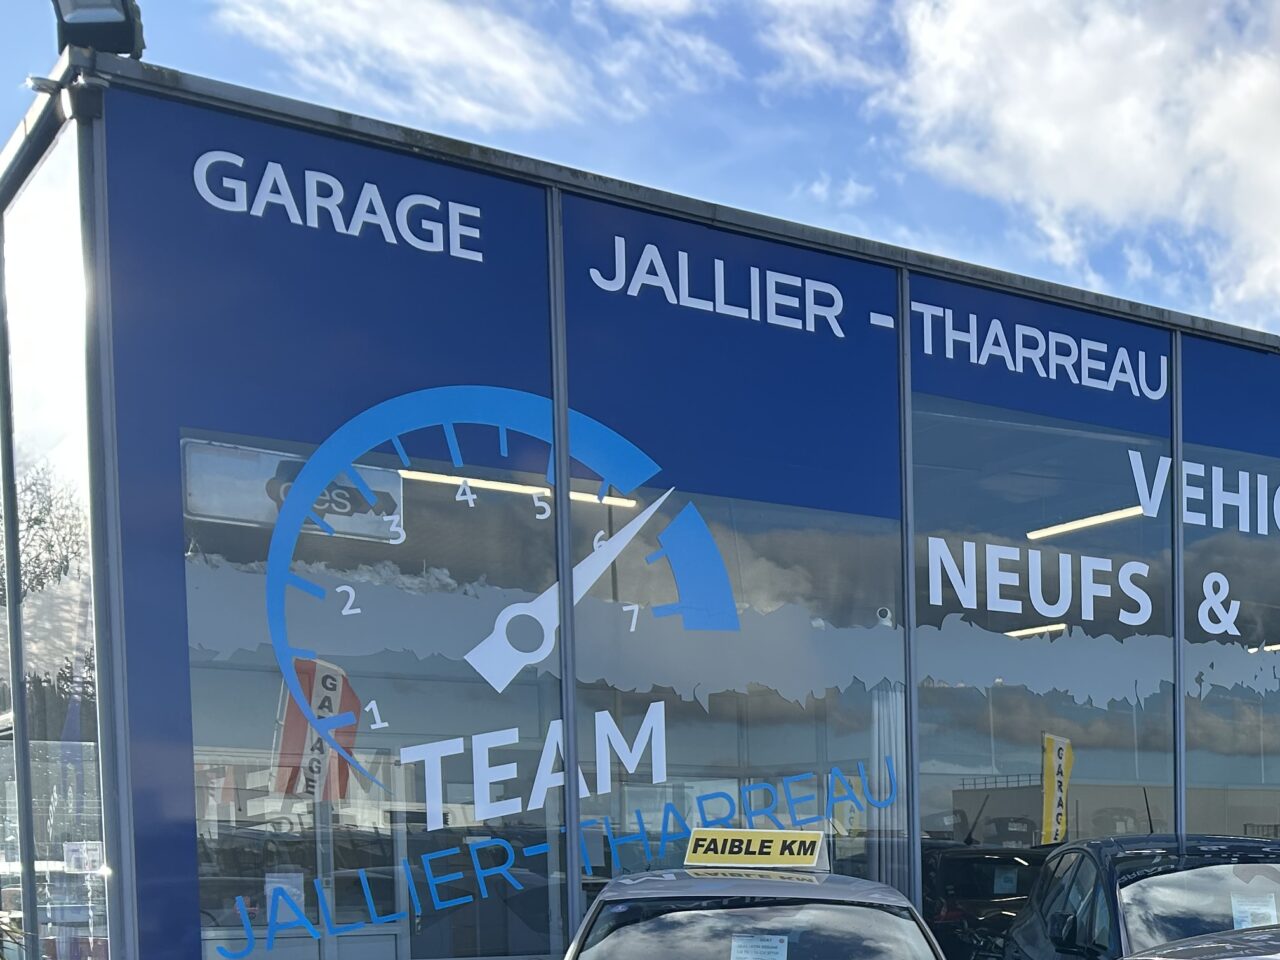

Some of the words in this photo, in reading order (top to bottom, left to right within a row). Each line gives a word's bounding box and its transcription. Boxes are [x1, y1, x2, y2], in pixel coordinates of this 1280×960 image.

[193, 150, 484, 263] GARAGE
[589, 234, 845, 338] JALLIER
[911, 301, 1168, 400] THARREAU
[455, 480, 477, 507] 4
[532, 491, 551, 520] 5
[383, 515, 407, 545] 3
[335, 585, 362, 616] 2
[928, 536, 1152, 626] NEUFS
[1198, 572, 1241, 636] &
[622, 604, 639, 632] 7
[364, 700, 389, 730] 1
[400, 701, 667, 832] TEAM
[1054, 747, 1064, 841] GARAGE
[691, 838, 772, 856] FAIBLE
[779, 840, 817, 857] KM
